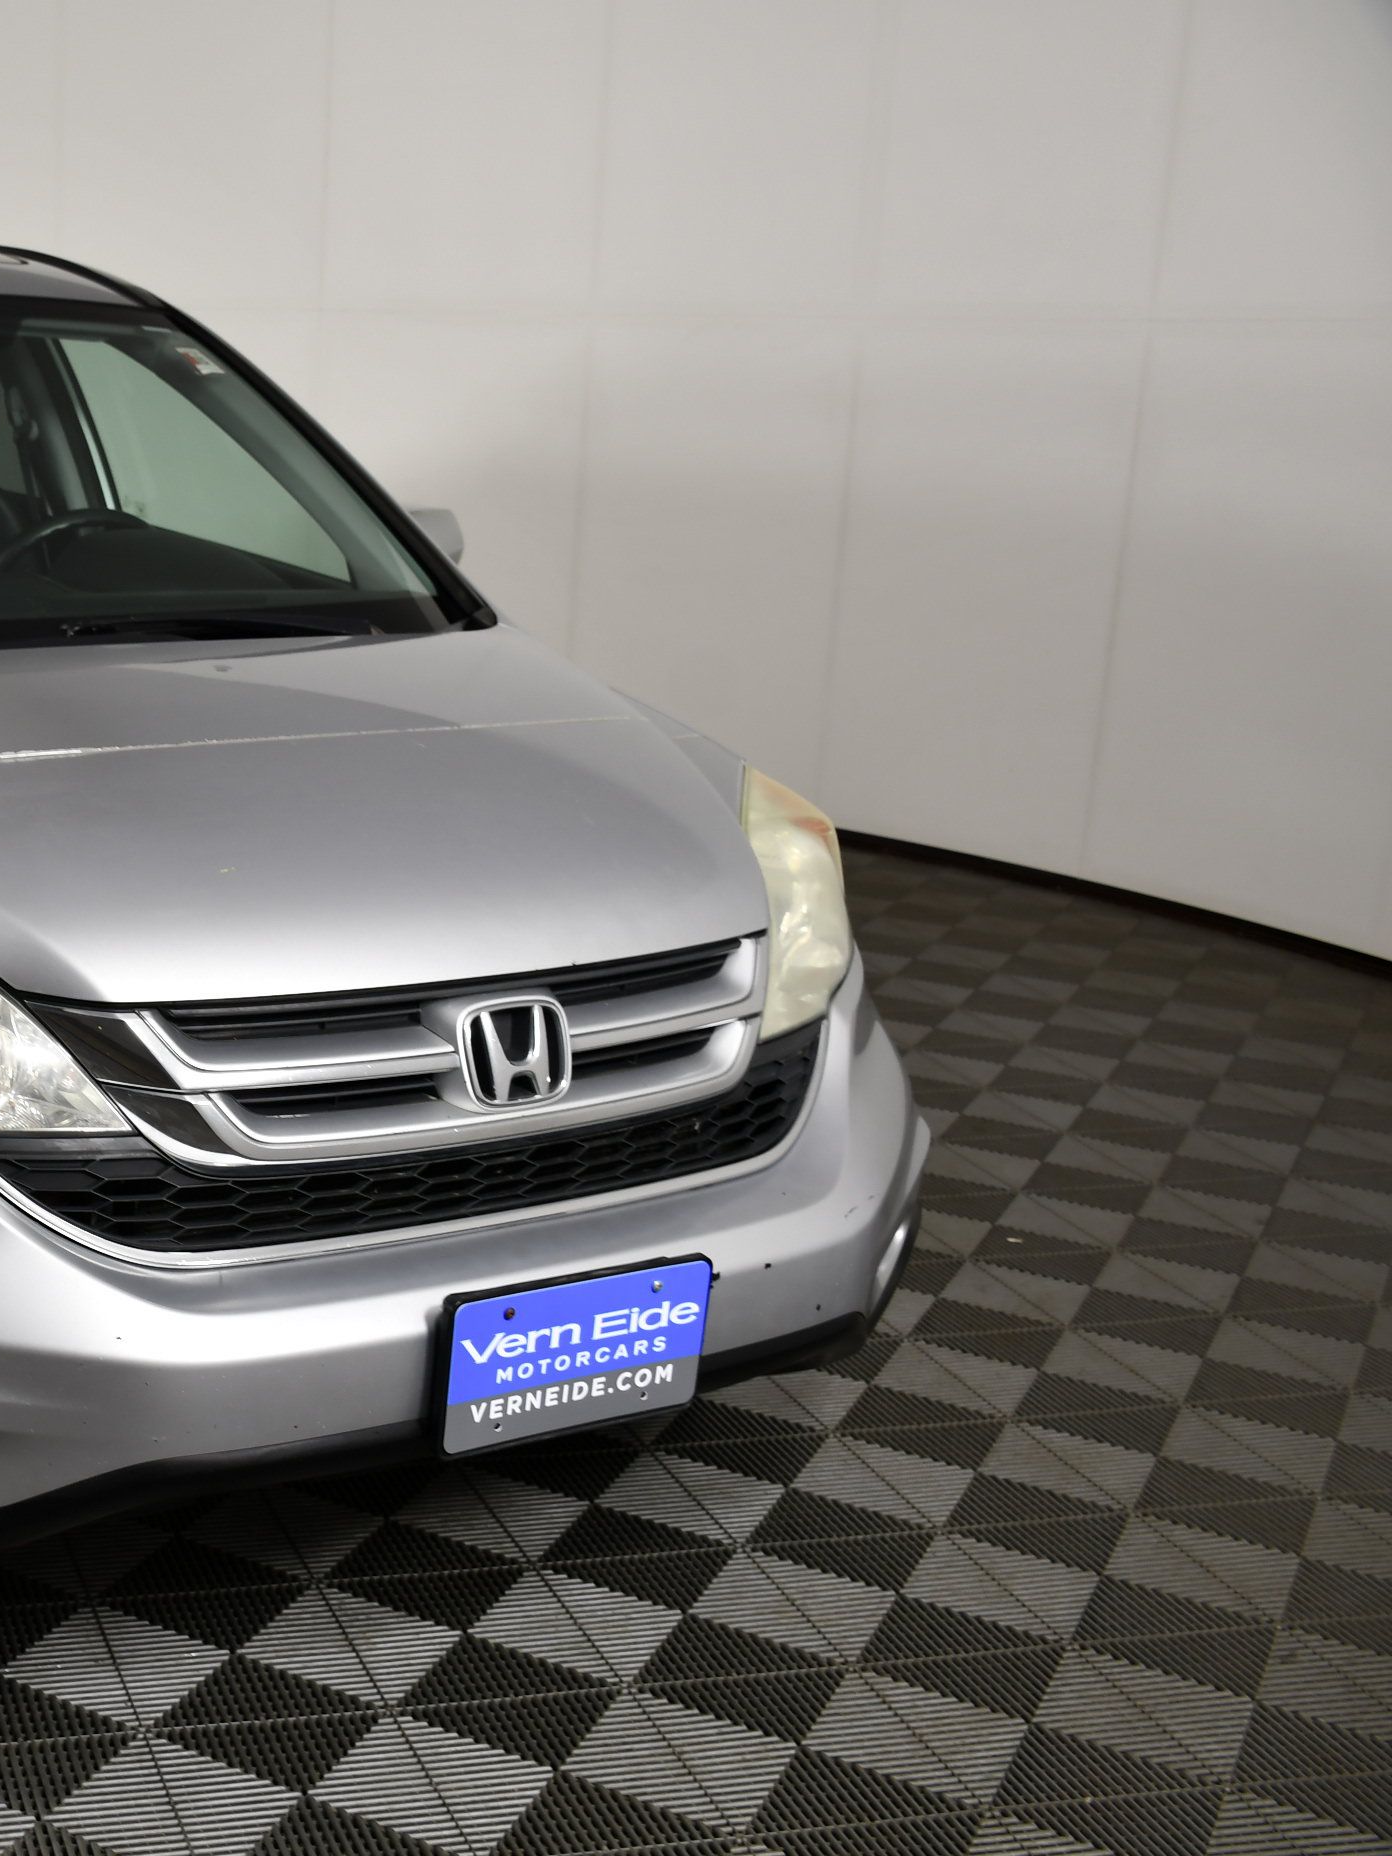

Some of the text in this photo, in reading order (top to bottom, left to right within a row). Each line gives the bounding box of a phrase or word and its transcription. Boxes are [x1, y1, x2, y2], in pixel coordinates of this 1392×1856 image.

[460, 1301, 701, 1365] Vern Eide
[496, 1336, 668, 1385] MOTORCARS
[470, 1363, 675, 1424] VERNEIDE.COM
